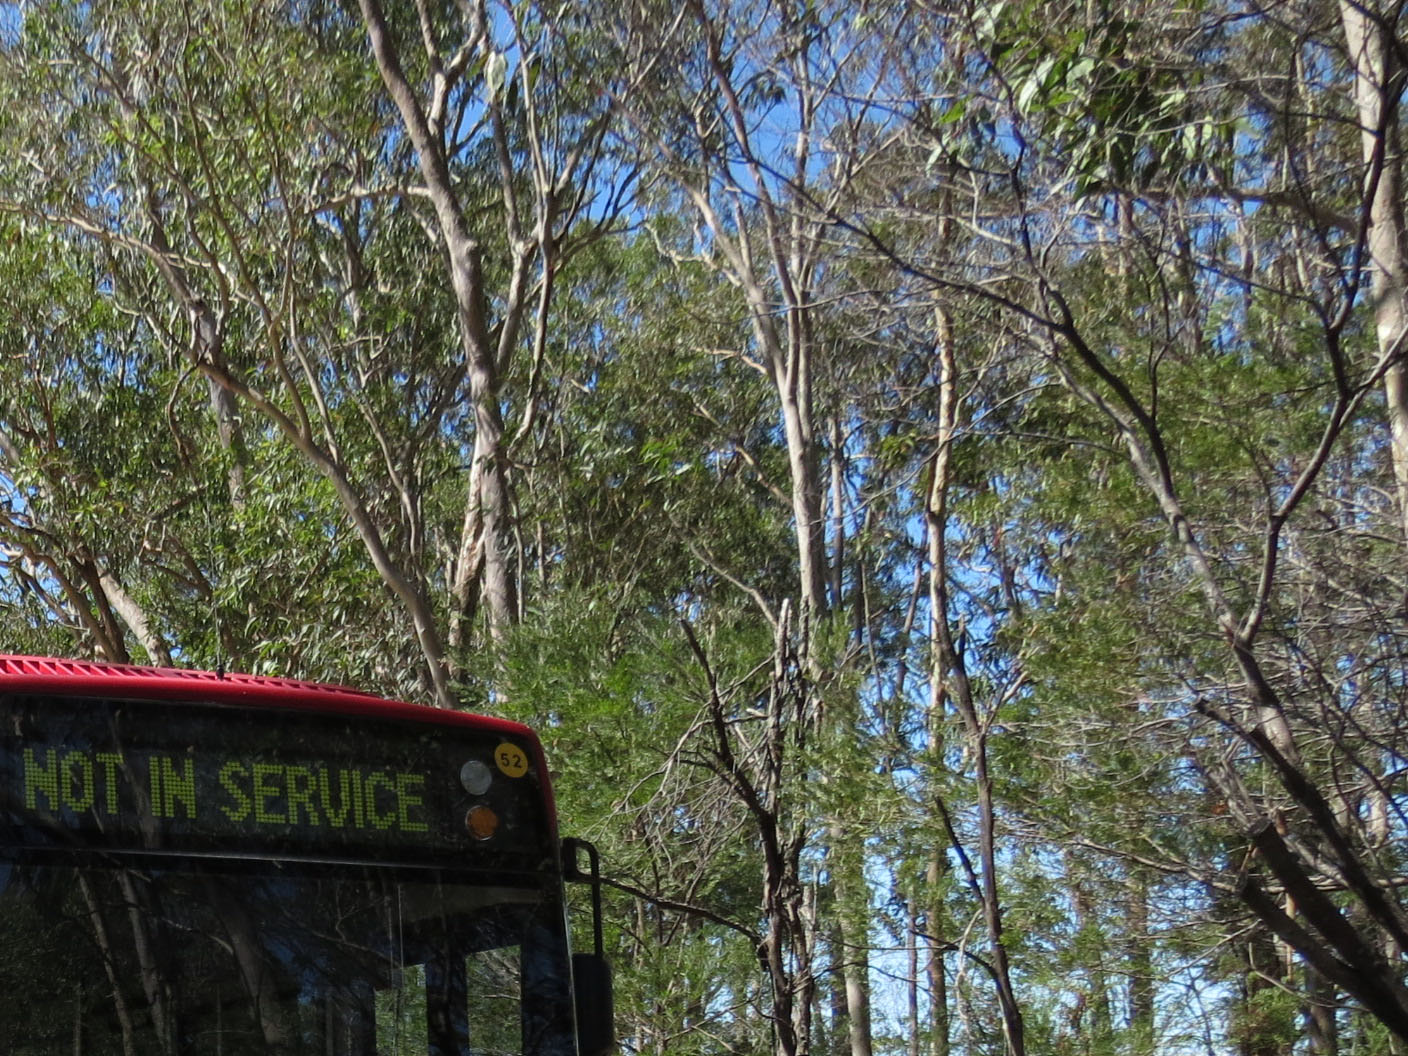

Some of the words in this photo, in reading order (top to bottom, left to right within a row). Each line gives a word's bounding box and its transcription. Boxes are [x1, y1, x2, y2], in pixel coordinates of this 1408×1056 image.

[500, 751, 523, 767] 52
[22, 747, 124, 816] NOT
[148, 756, 197, 819] IN
[220, 760, 429, 831] SERVICE
